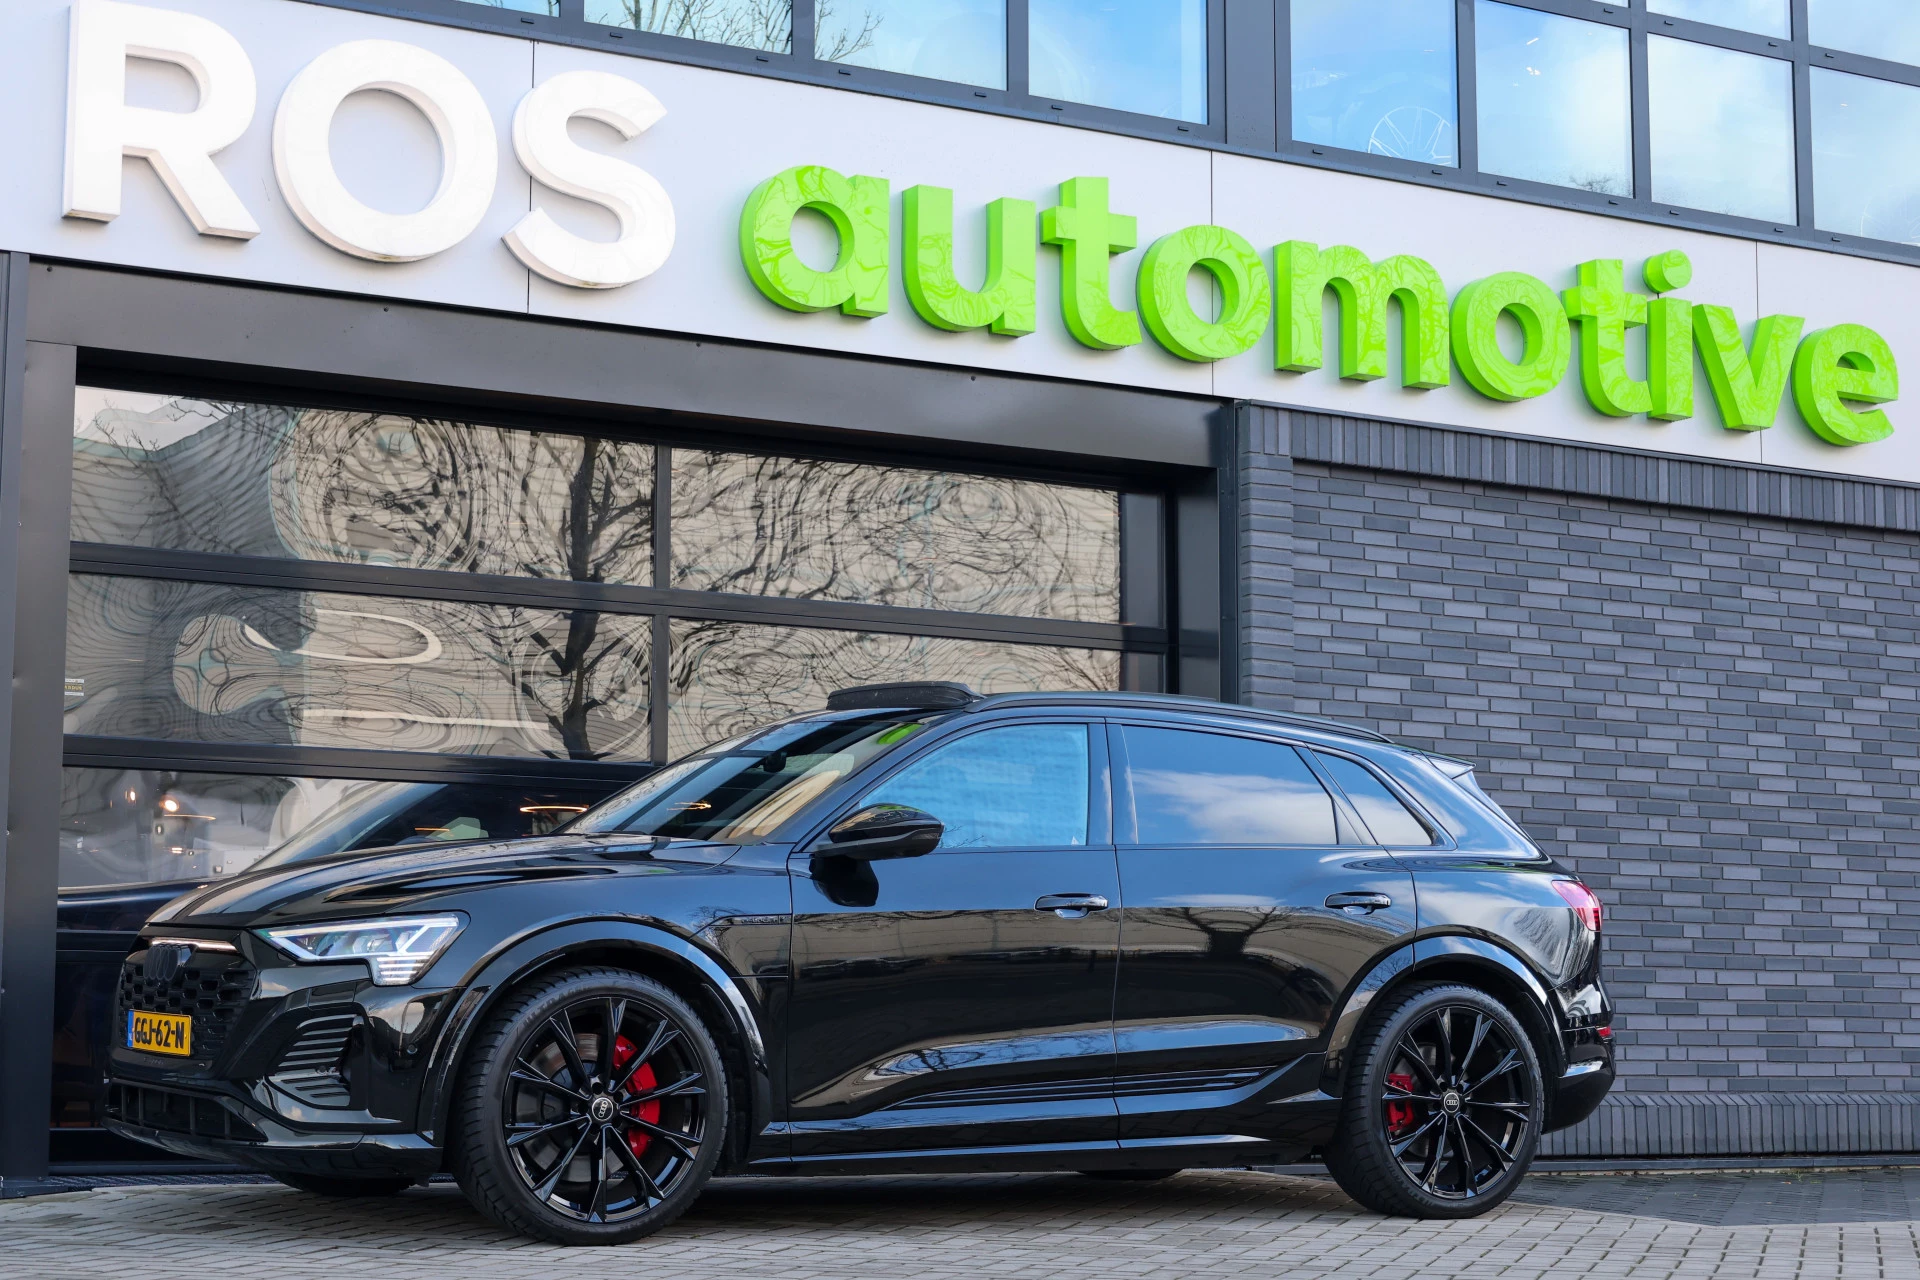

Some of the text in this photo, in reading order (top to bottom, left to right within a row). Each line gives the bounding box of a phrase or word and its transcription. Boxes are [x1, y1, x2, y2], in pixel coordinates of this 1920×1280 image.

[62, 0, 1899, 447] ROS automotive
[134, 1017, 185, 1049] GGJ-62-N
